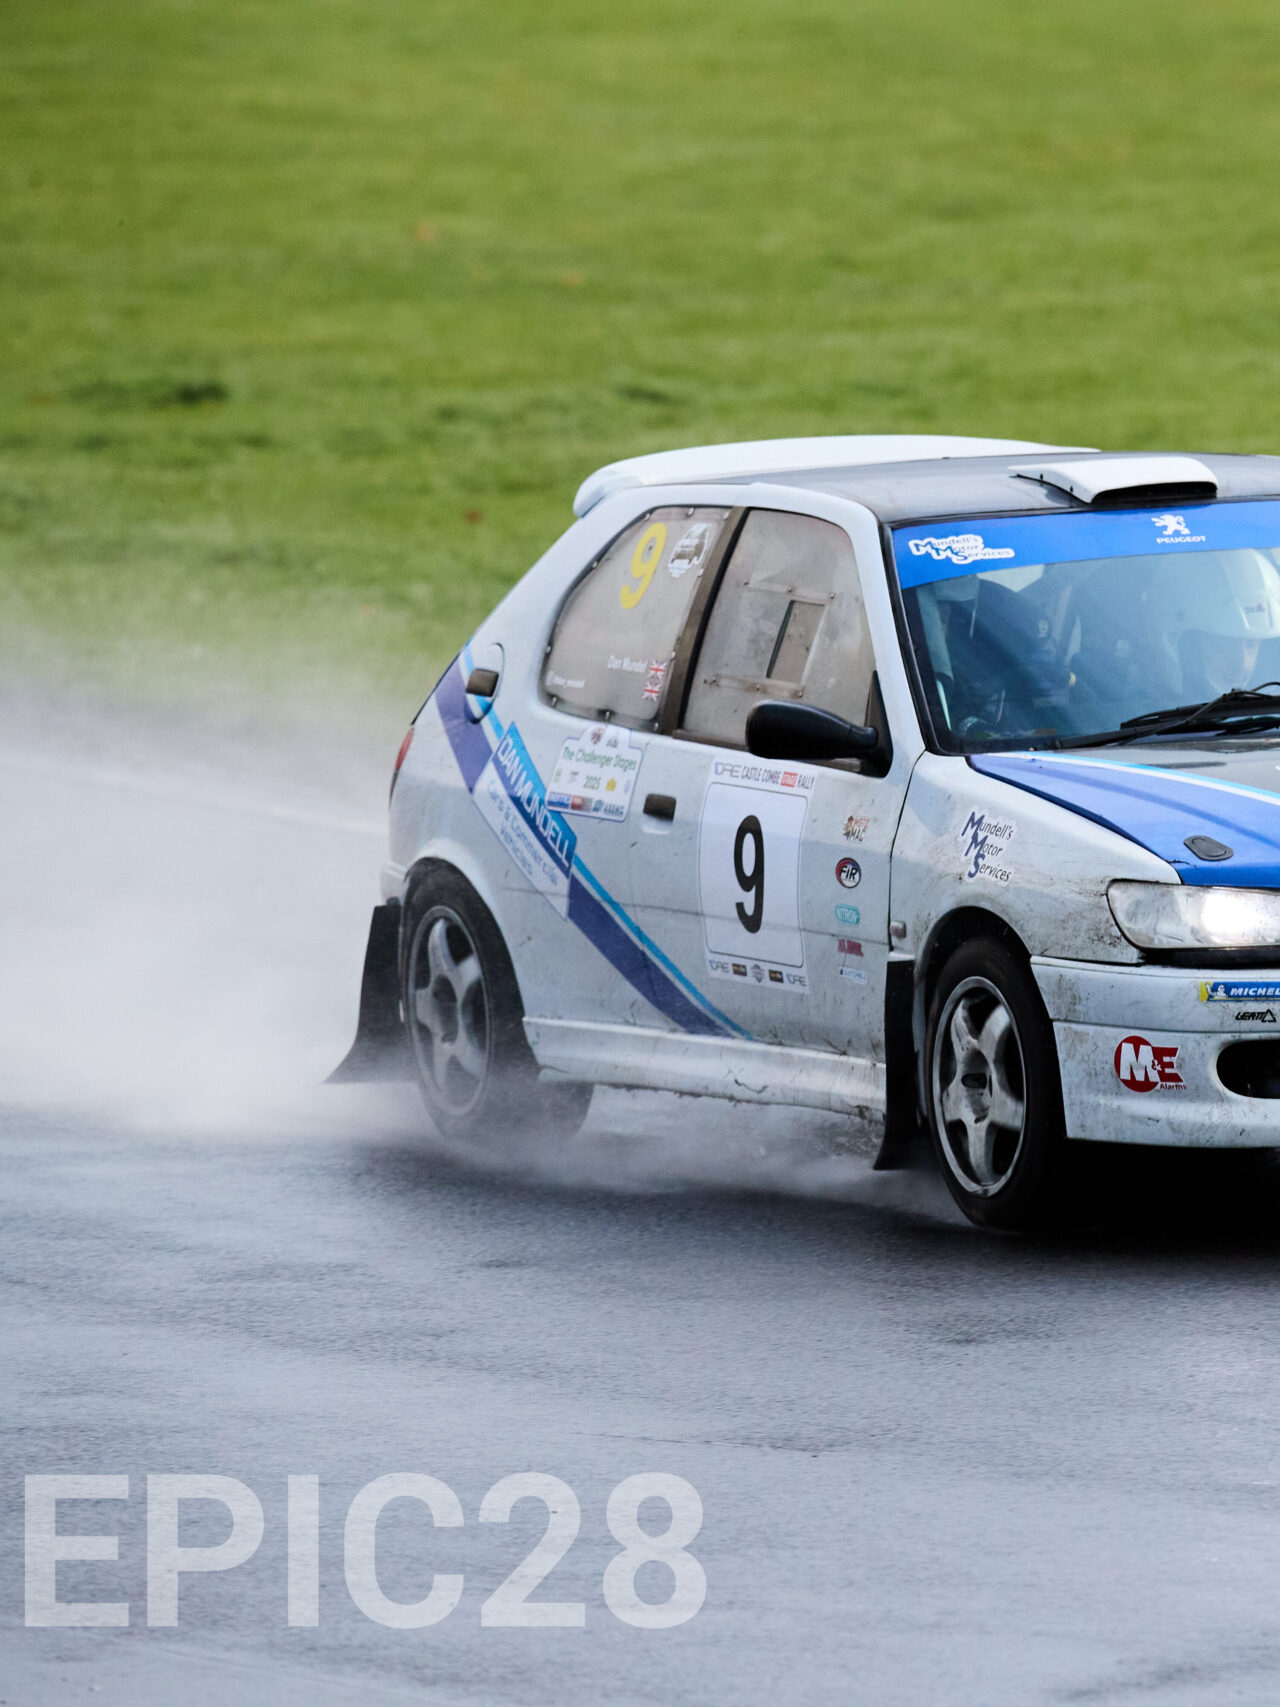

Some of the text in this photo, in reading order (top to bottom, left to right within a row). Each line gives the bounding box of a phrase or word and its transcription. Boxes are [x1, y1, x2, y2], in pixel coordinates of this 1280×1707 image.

[1156, 535, 1206, 544] PEUGEOT
[620, 522, 667, 609] 9
[497, 735, 524, 785] DAN
[514, 771, 570, 868] MUNDELL
[961, 811, 1014, 841] Mundell's
[964, 835, 1004, 858] Motor
[734, 815, 765, 934] 9
[968, 853, 1012, 882] Services
